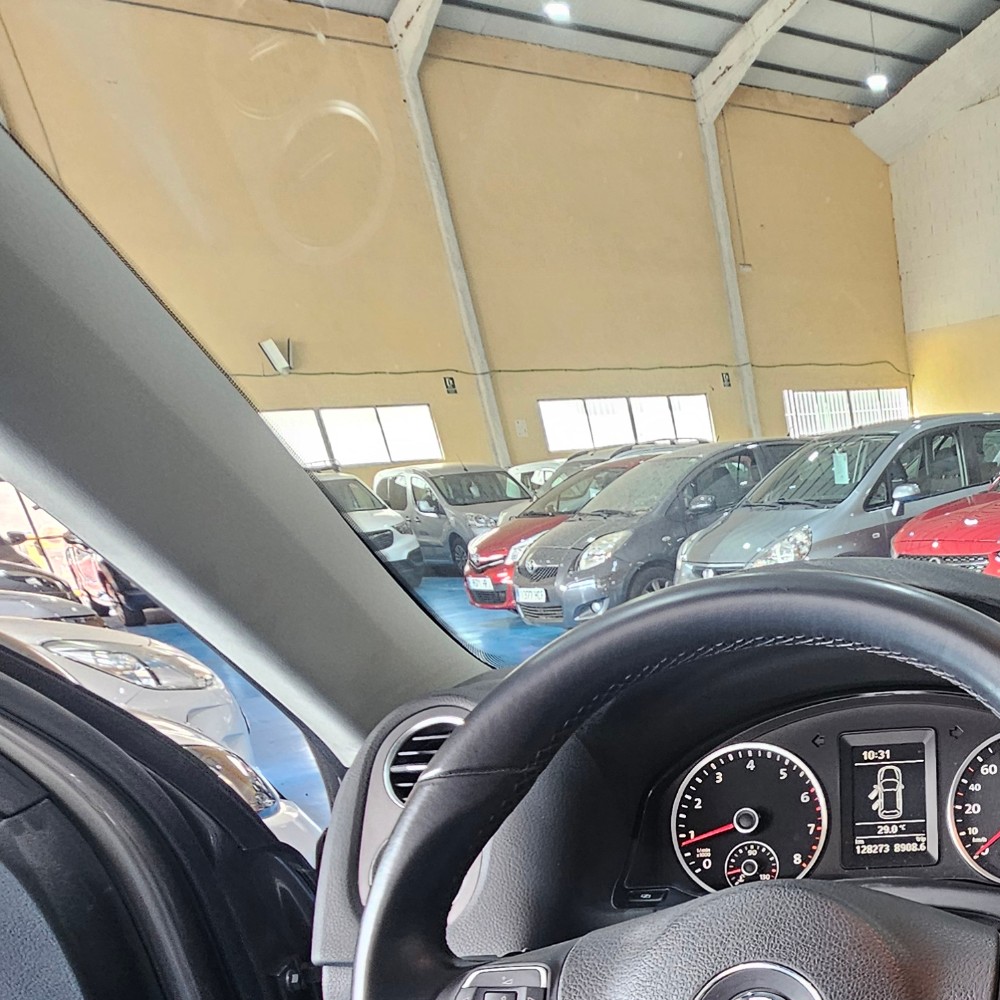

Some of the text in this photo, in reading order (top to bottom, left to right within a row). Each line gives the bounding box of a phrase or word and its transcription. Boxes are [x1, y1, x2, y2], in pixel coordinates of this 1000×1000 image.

[862, 749, 891, 760] 10:31
[745, 759, 756, 771] 4
[980, 764, 998, 775] 60
[715, 772, 723, 784] 3
[779, 768, 788, 780] 5
[969, 783, 981, 792] 40
[800, 792, 810, 803] 6
[694, 798, 702, 809] 2
[964, 803, 981, 814] 20
[688, 830, 695, 839] 1
[807, 823, 816, 835] 7
[877, 825, 898, 835] 29.0
[967, 827, 979, 835] 10
[855, 844, 890, 855] 128273
[893, 842, 926, 853] 8908.6
[702, 858, 712, 869] 0
[793, 853, 802, 865] 8
